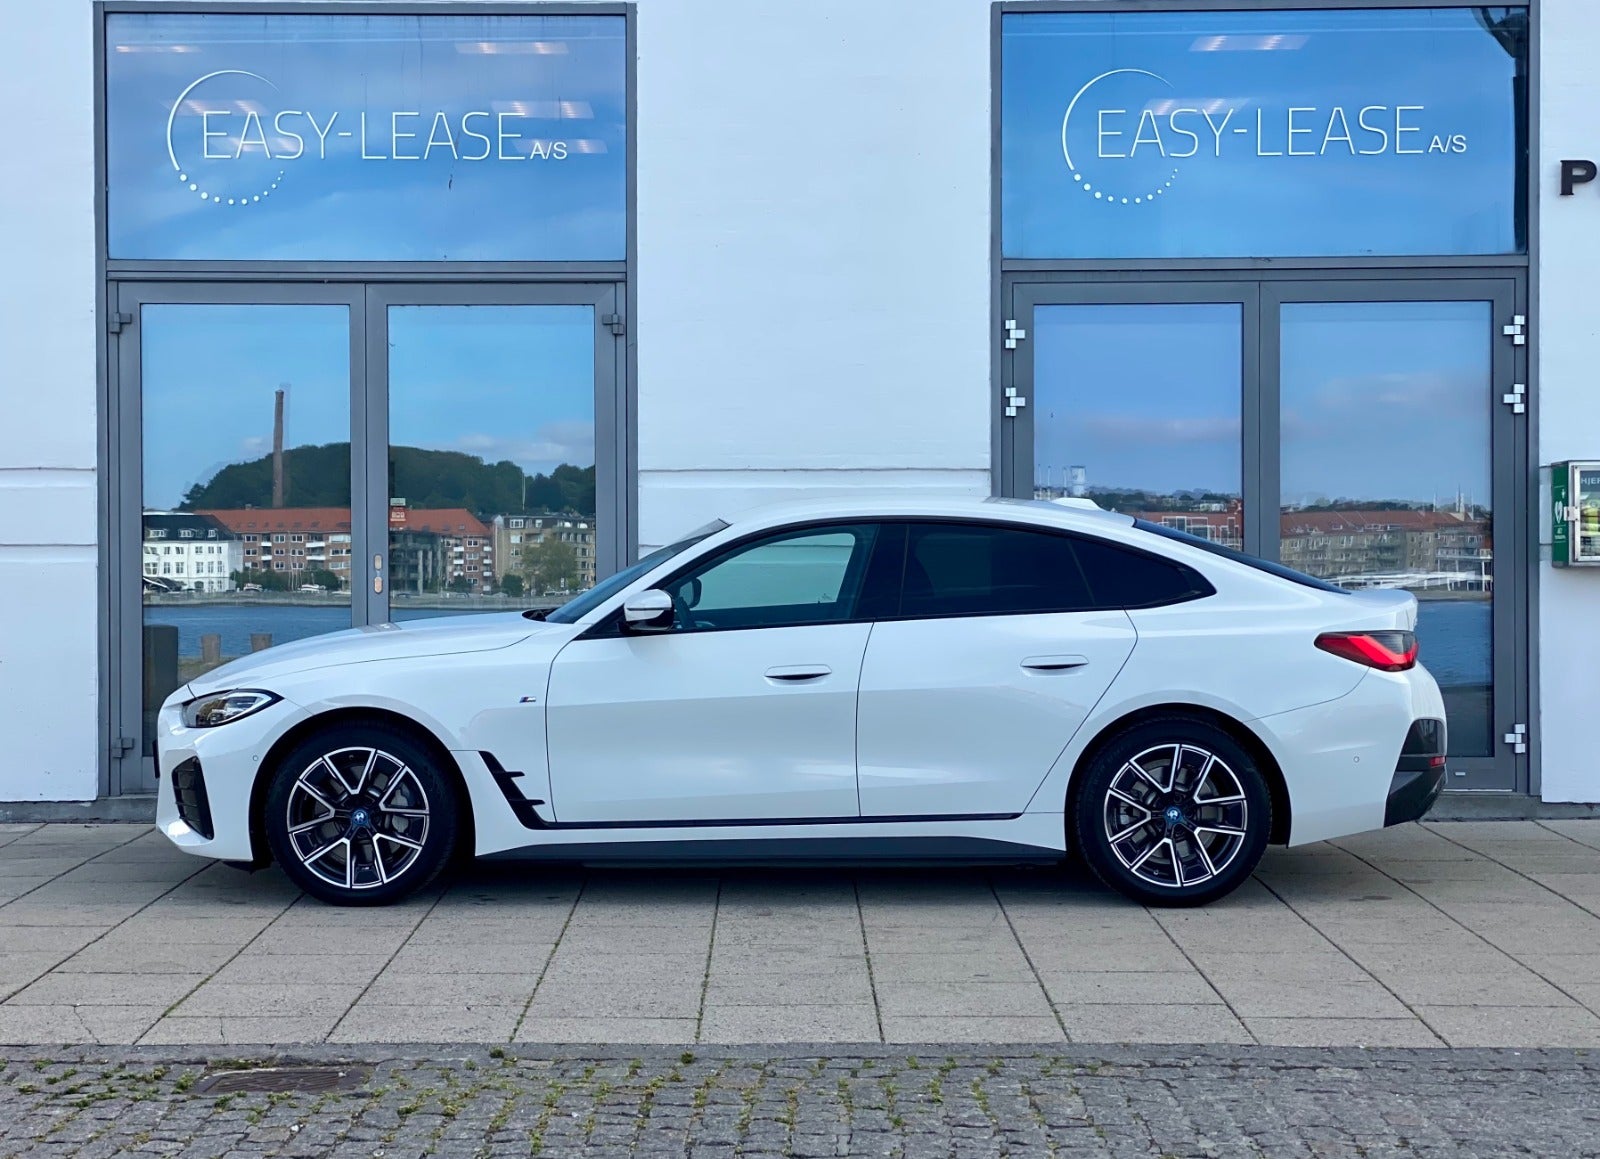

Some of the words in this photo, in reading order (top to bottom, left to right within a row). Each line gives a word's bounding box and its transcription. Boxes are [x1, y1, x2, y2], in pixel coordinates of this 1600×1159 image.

[203, 111, 526, 160] EASY-LEASE
[530, 142, 569, 160] A/S
[1097, 106, 1425, 157] EASY-LEASE
[1428, 135, 1467, 153] A/S
